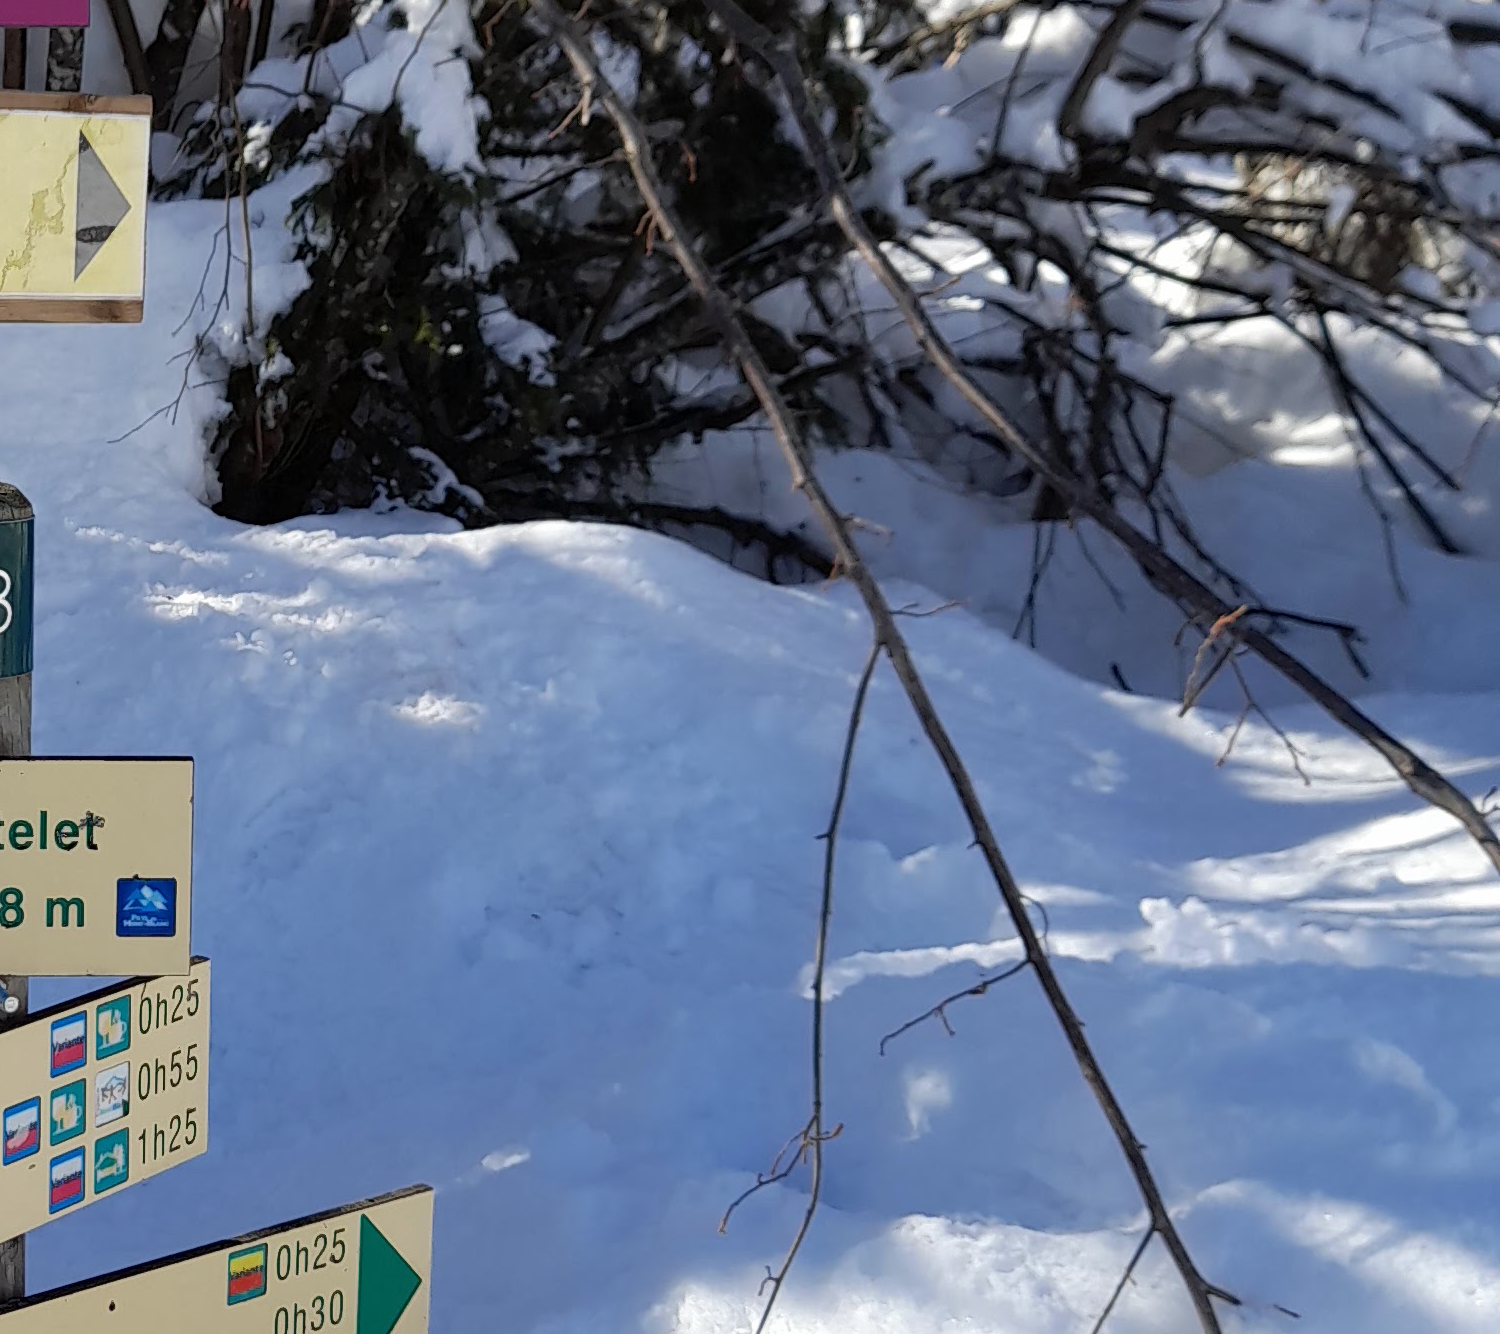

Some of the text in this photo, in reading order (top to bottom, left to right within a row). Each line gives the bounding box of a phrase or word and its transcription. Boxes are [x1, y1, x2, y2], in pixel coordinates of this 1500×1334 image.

[47, 898, 84, 927] m
[139, 979, 199, 1034] 0h25
[139, 1044, 197, 1100] 0h55
[138, 1108, 197, 1164] 1h25
[277, 1228, 345, 1280] 0h25
